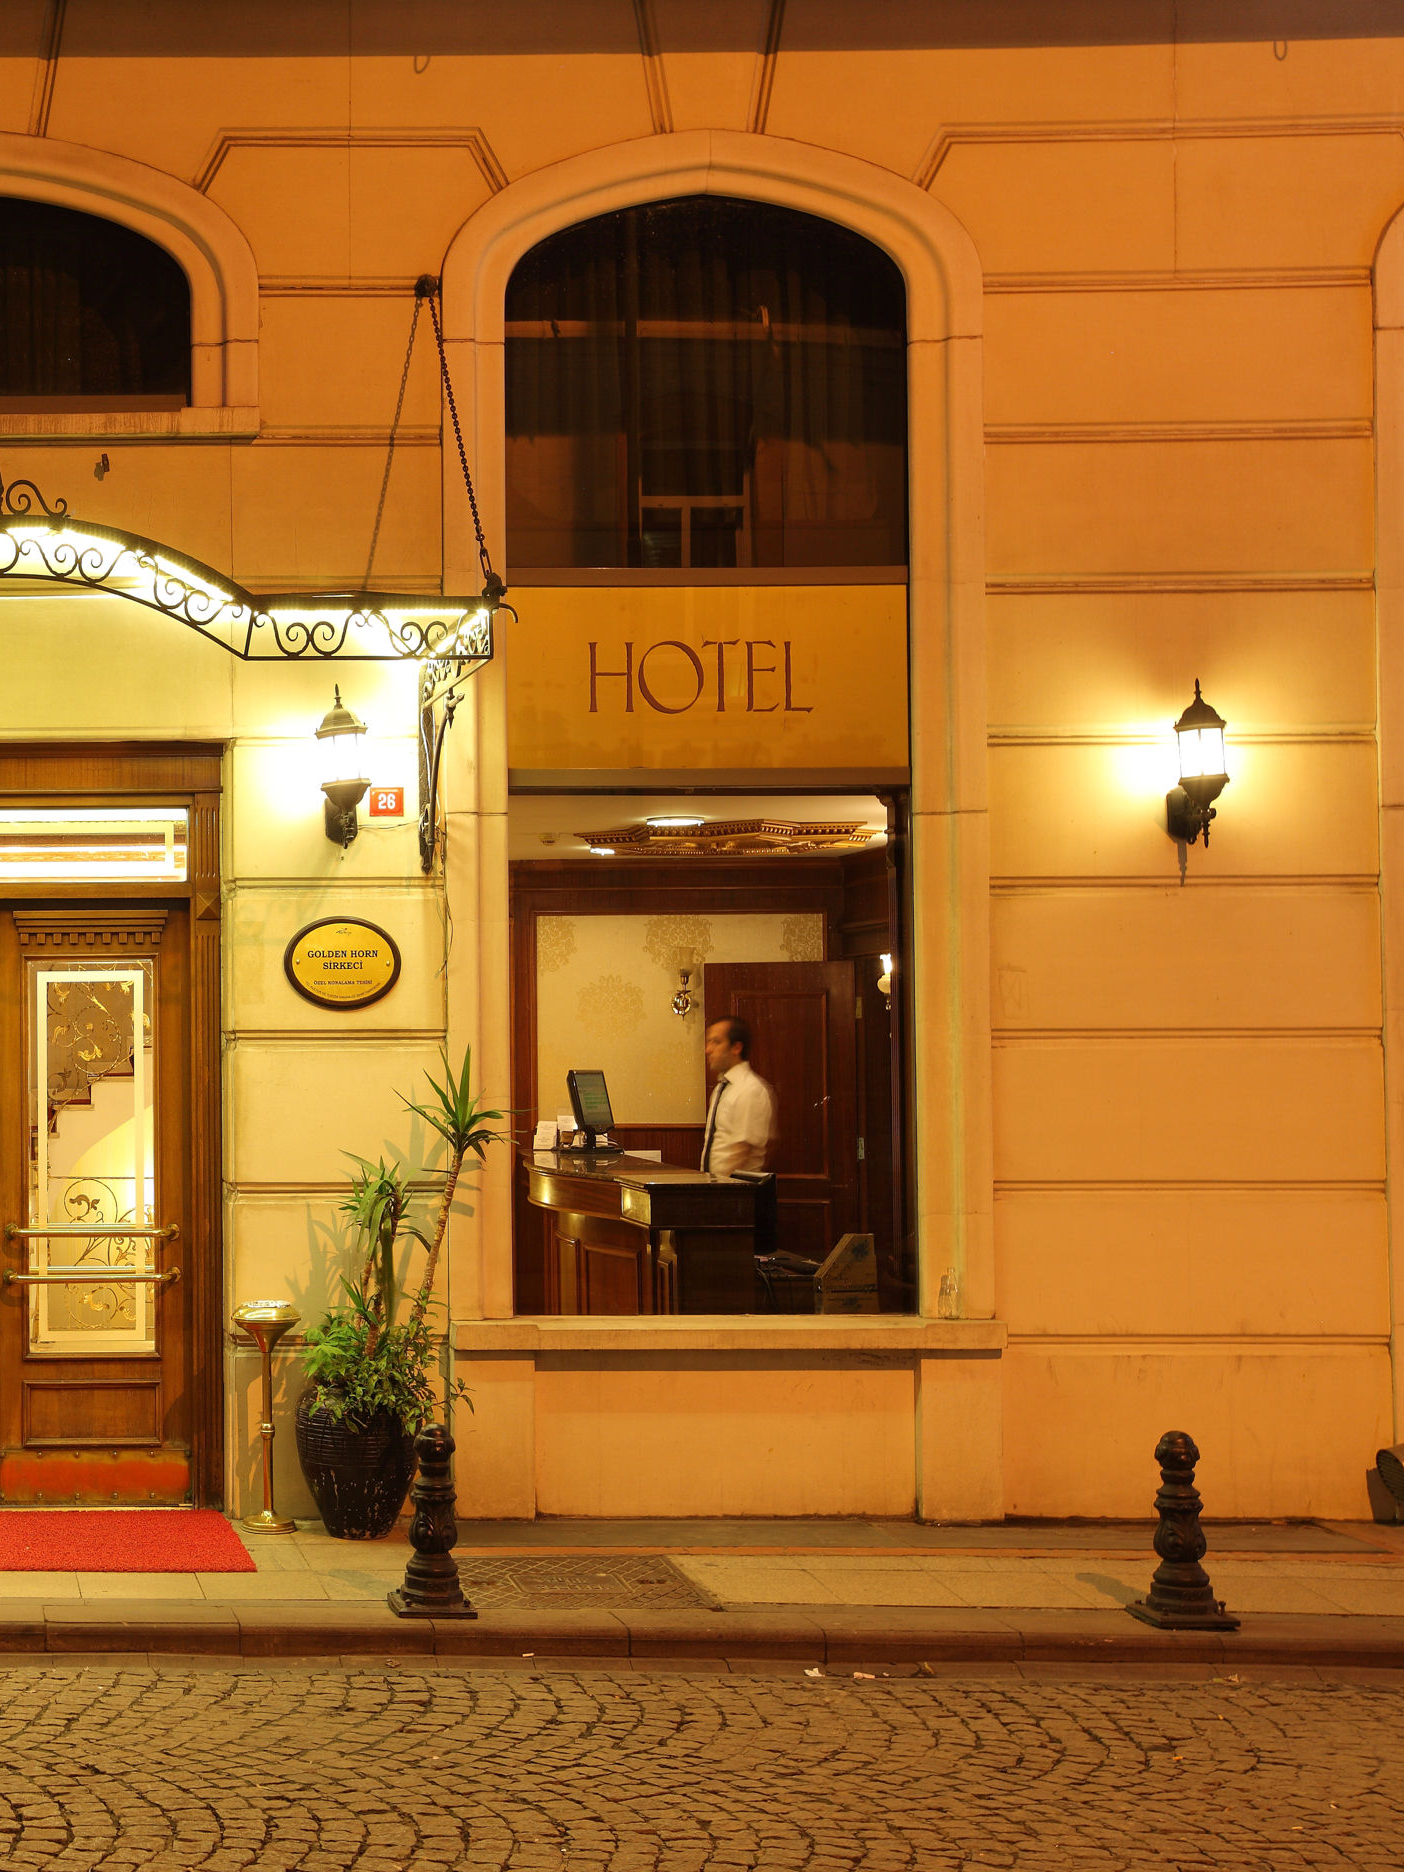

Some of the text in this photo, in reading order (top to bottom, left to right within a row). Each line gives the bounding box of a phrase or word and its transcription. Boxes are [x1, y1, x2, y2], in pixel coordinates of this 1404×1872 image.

[588, 638, 813, 714] HOTEL
[378, 793, 396, 809] 26
[307, 949, 378, 959] GOLDEN HORN
[322, 960, 363, 970] SİRKECİ
